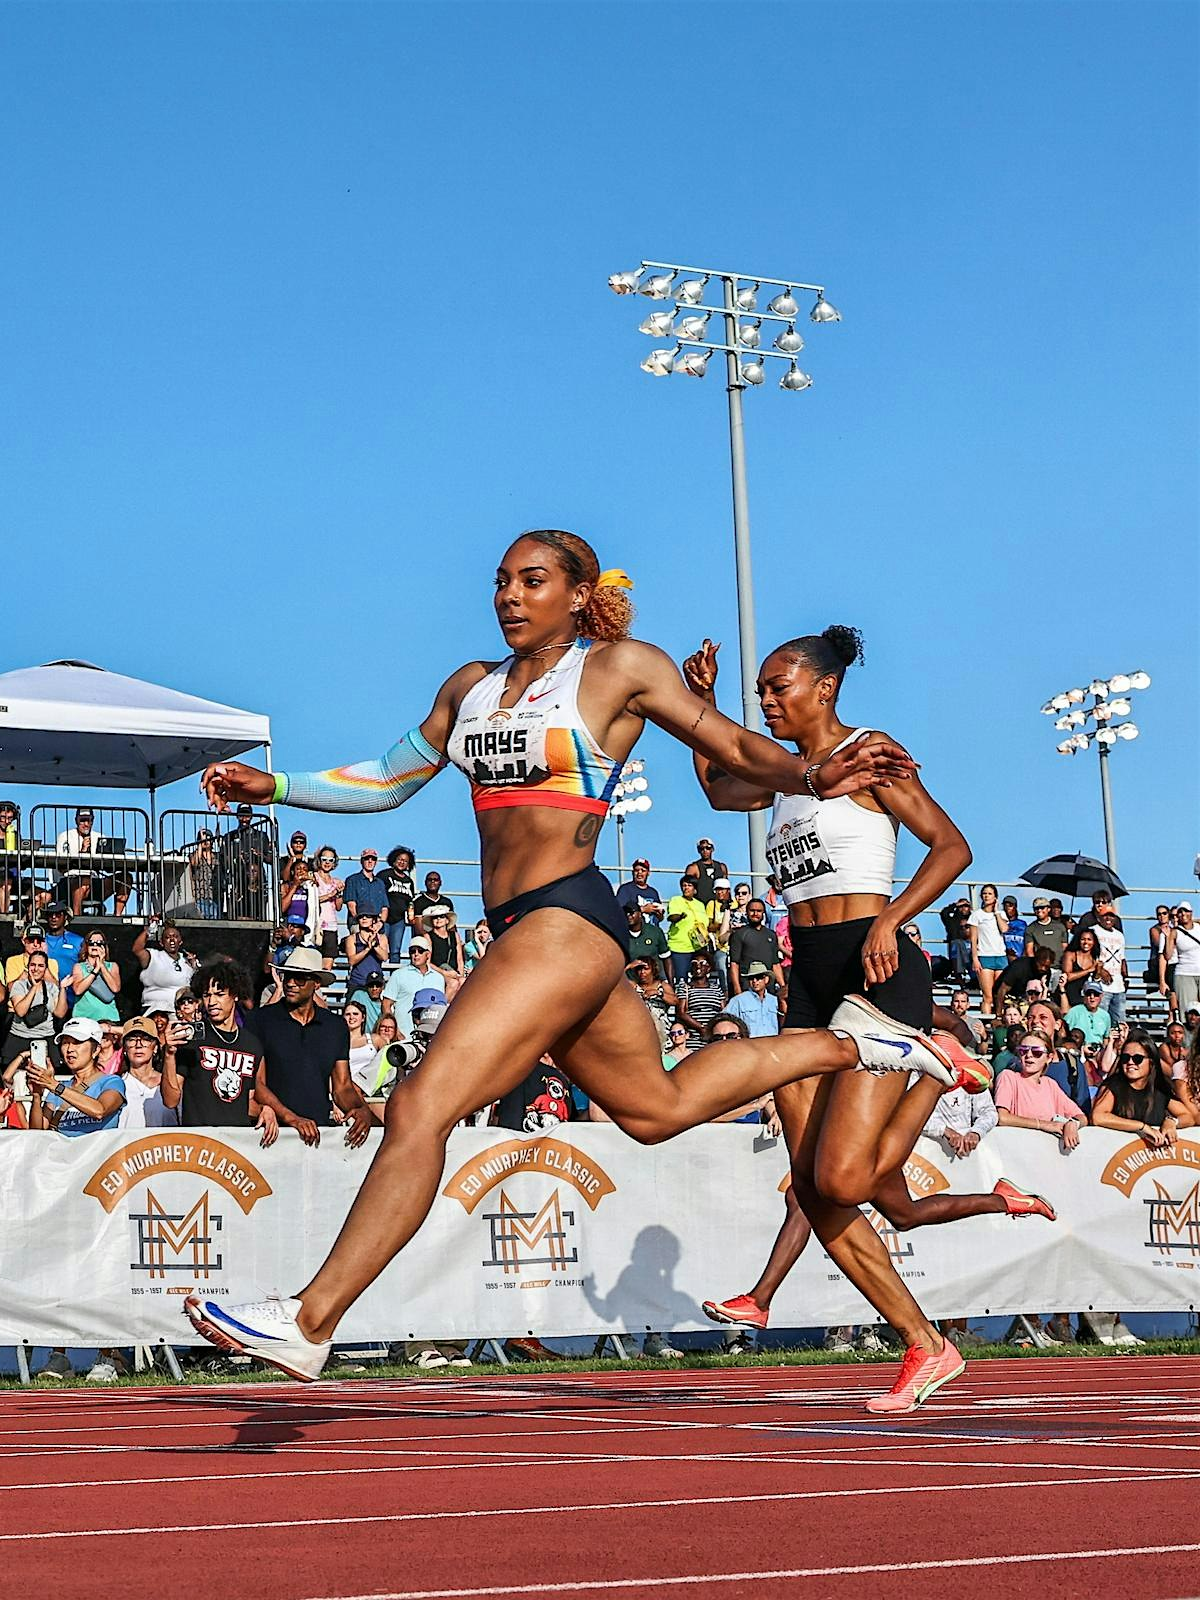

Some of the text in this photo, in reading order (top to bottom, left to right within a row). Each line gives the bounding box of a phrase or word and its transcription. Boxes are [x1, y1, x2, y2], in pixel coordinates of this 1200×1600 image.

[464, 729, 528, 757] MAYS
[766, 831, 821, 865] STEVENS
[202, 1047, 255, 1075] SIUE
[100, 1144, 257, 1197] ED MURPHEY CLASSIC
[460, 1147, 601, 1197] ED MURPHEY CLASSIC
[903, 1162, 936, 1192] SSIC
[1113, 1166, 1131, 1185] ED
[198, 1287, 230, 1295] CHAMPION
